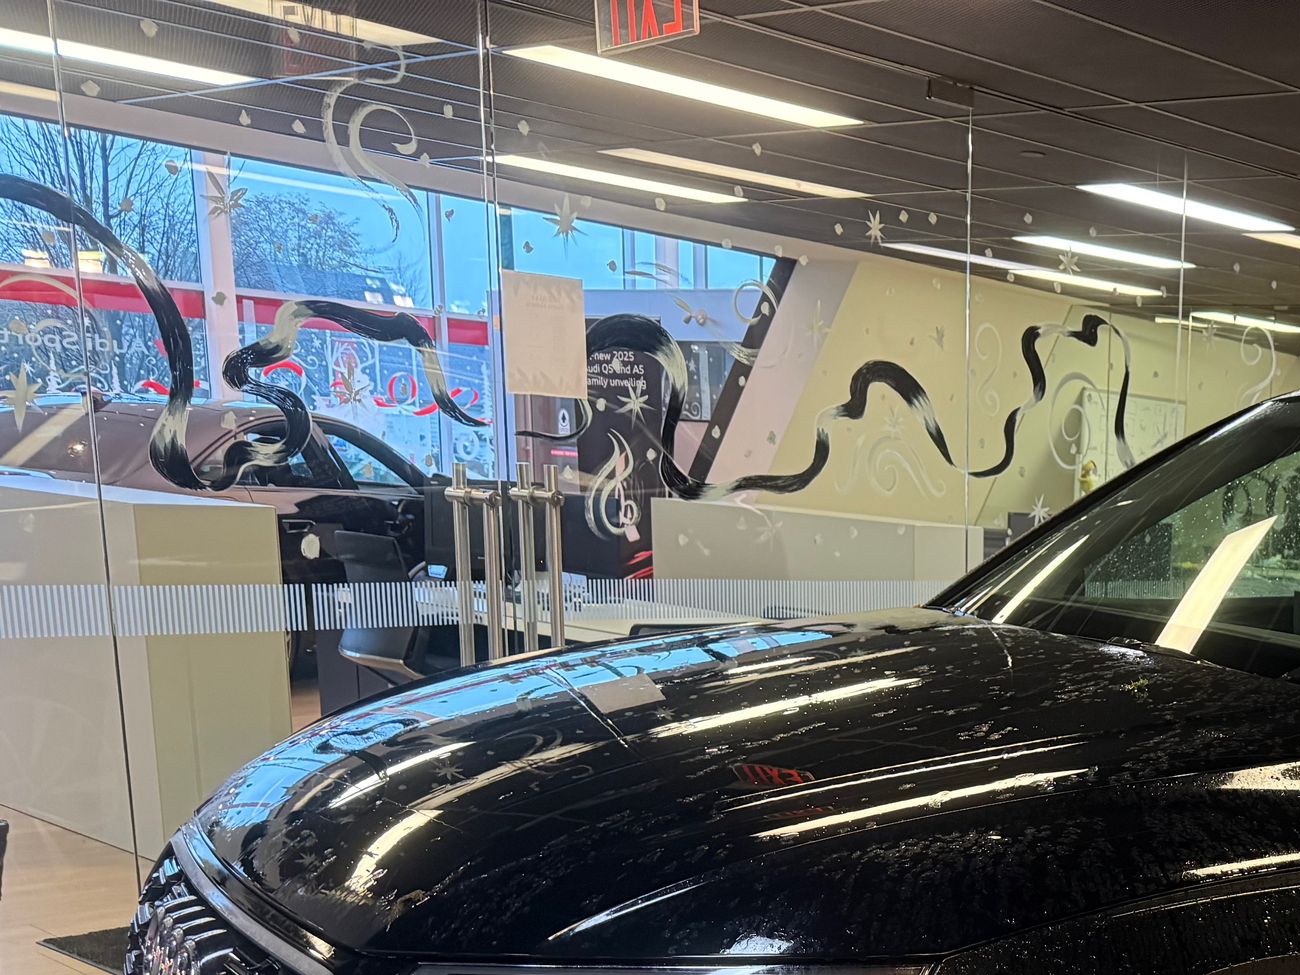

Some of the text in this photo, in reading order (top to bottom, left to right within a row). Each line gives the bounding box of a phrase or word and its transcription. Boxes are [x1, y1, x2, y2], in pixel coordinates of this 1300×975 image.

[612, 351, 635, 362] 2025
[588, 364, 600, 373] udi
[601, 364, 613, 375] Q5
[632, 365, 645, 375] A5
[588, 376, 608, 389] amily
